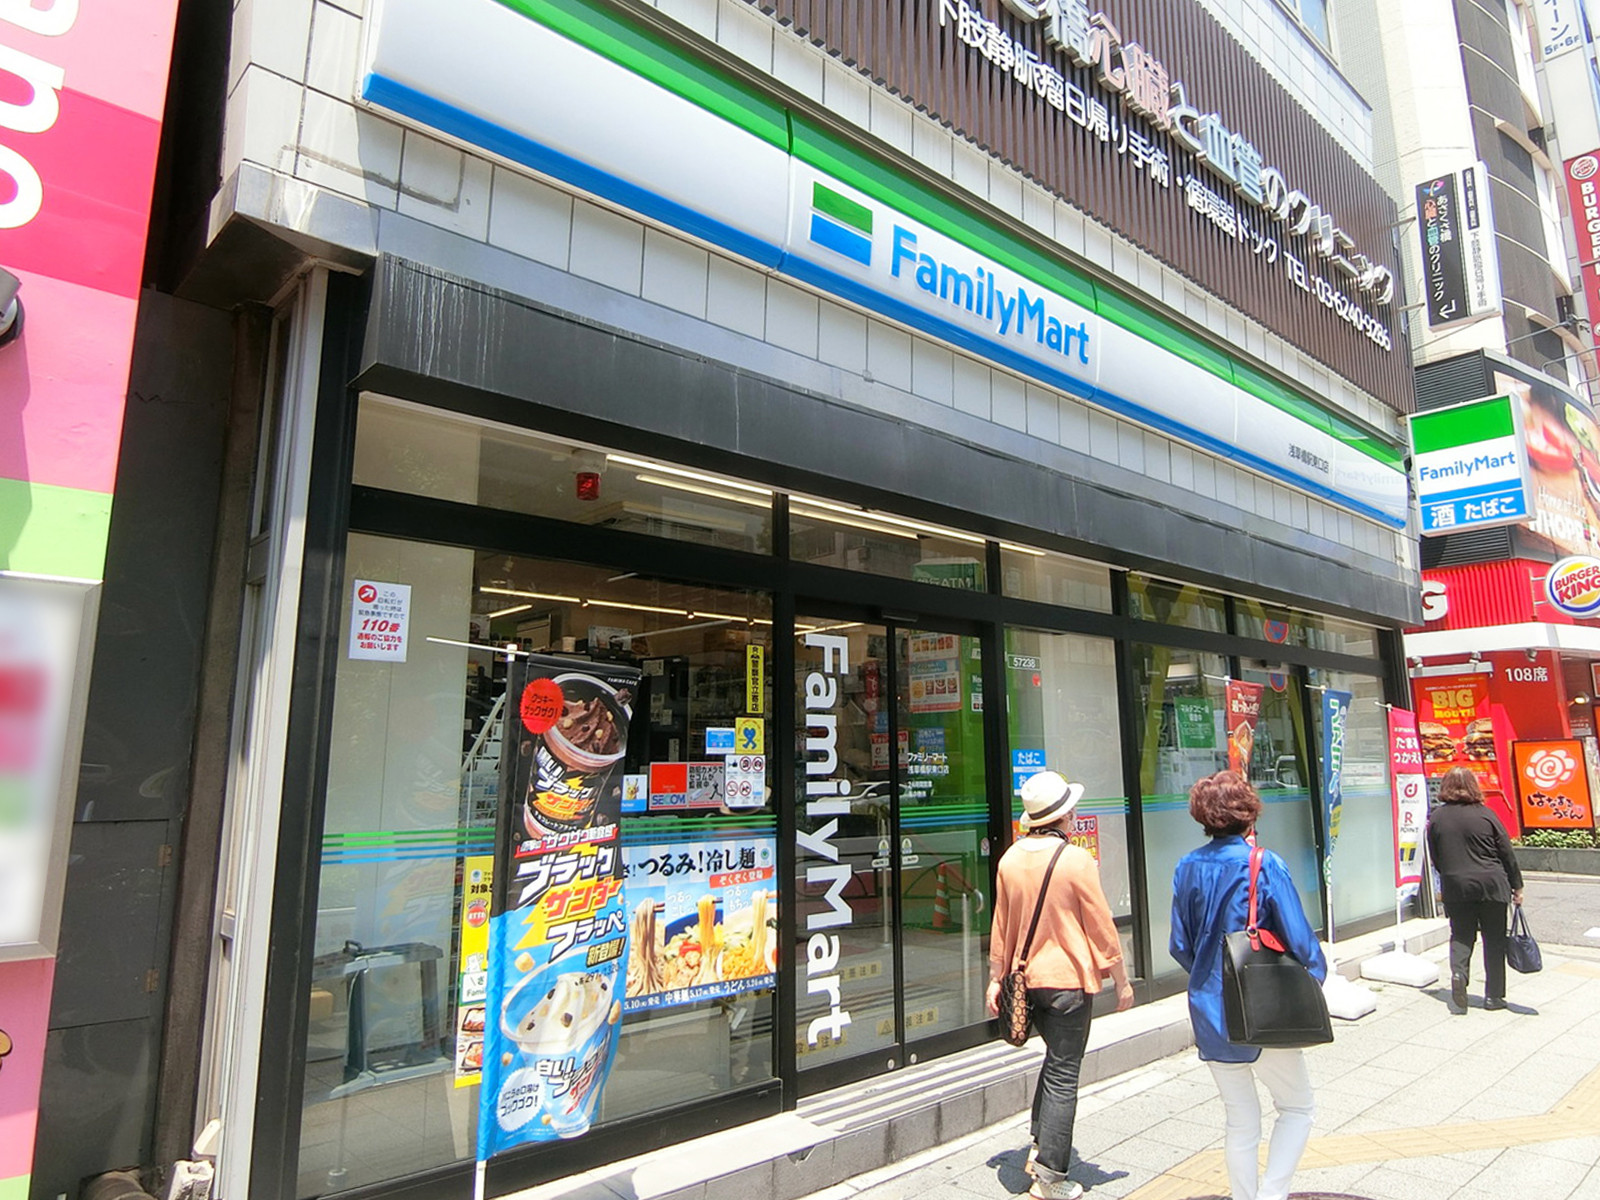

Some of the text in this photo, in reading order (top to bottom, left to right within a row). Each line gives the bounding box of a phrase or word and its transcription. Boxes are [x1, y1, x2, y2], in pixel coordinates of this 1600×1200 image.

[1544, 0, 1570, 41] ーン
[890, 224, 1092, 367] FamilyMart
[1419, 450, 1516, 482] FamilyMart
[1430, 496, 1518, 528] 酒 たばこ
[1554, 565, 1600, 592] BURGER
[1557, 577, 1600, 604] KING
[361, 618, 400, 633] 110番
[1505, 667, 1548, 683] 108席
[1431, 688, 1475, 710] BIG
[907, 752, 948, 763] ファミリーマート
[1017, 752, 1041, 765] たばこ
[1394, 751, 1423, 765] つかえ
[652, 793, 686, 806] SECOM
[1552, 807, 1584, 821] うどん
[796, 633, 853, 1046] FamilyMart
[516, 846, 615, 905] ブラック
[544, 876, 624, 919] サンダー
[545, 910, 626, 963] フラッペ
[723, 980, 746, 995] うどん
